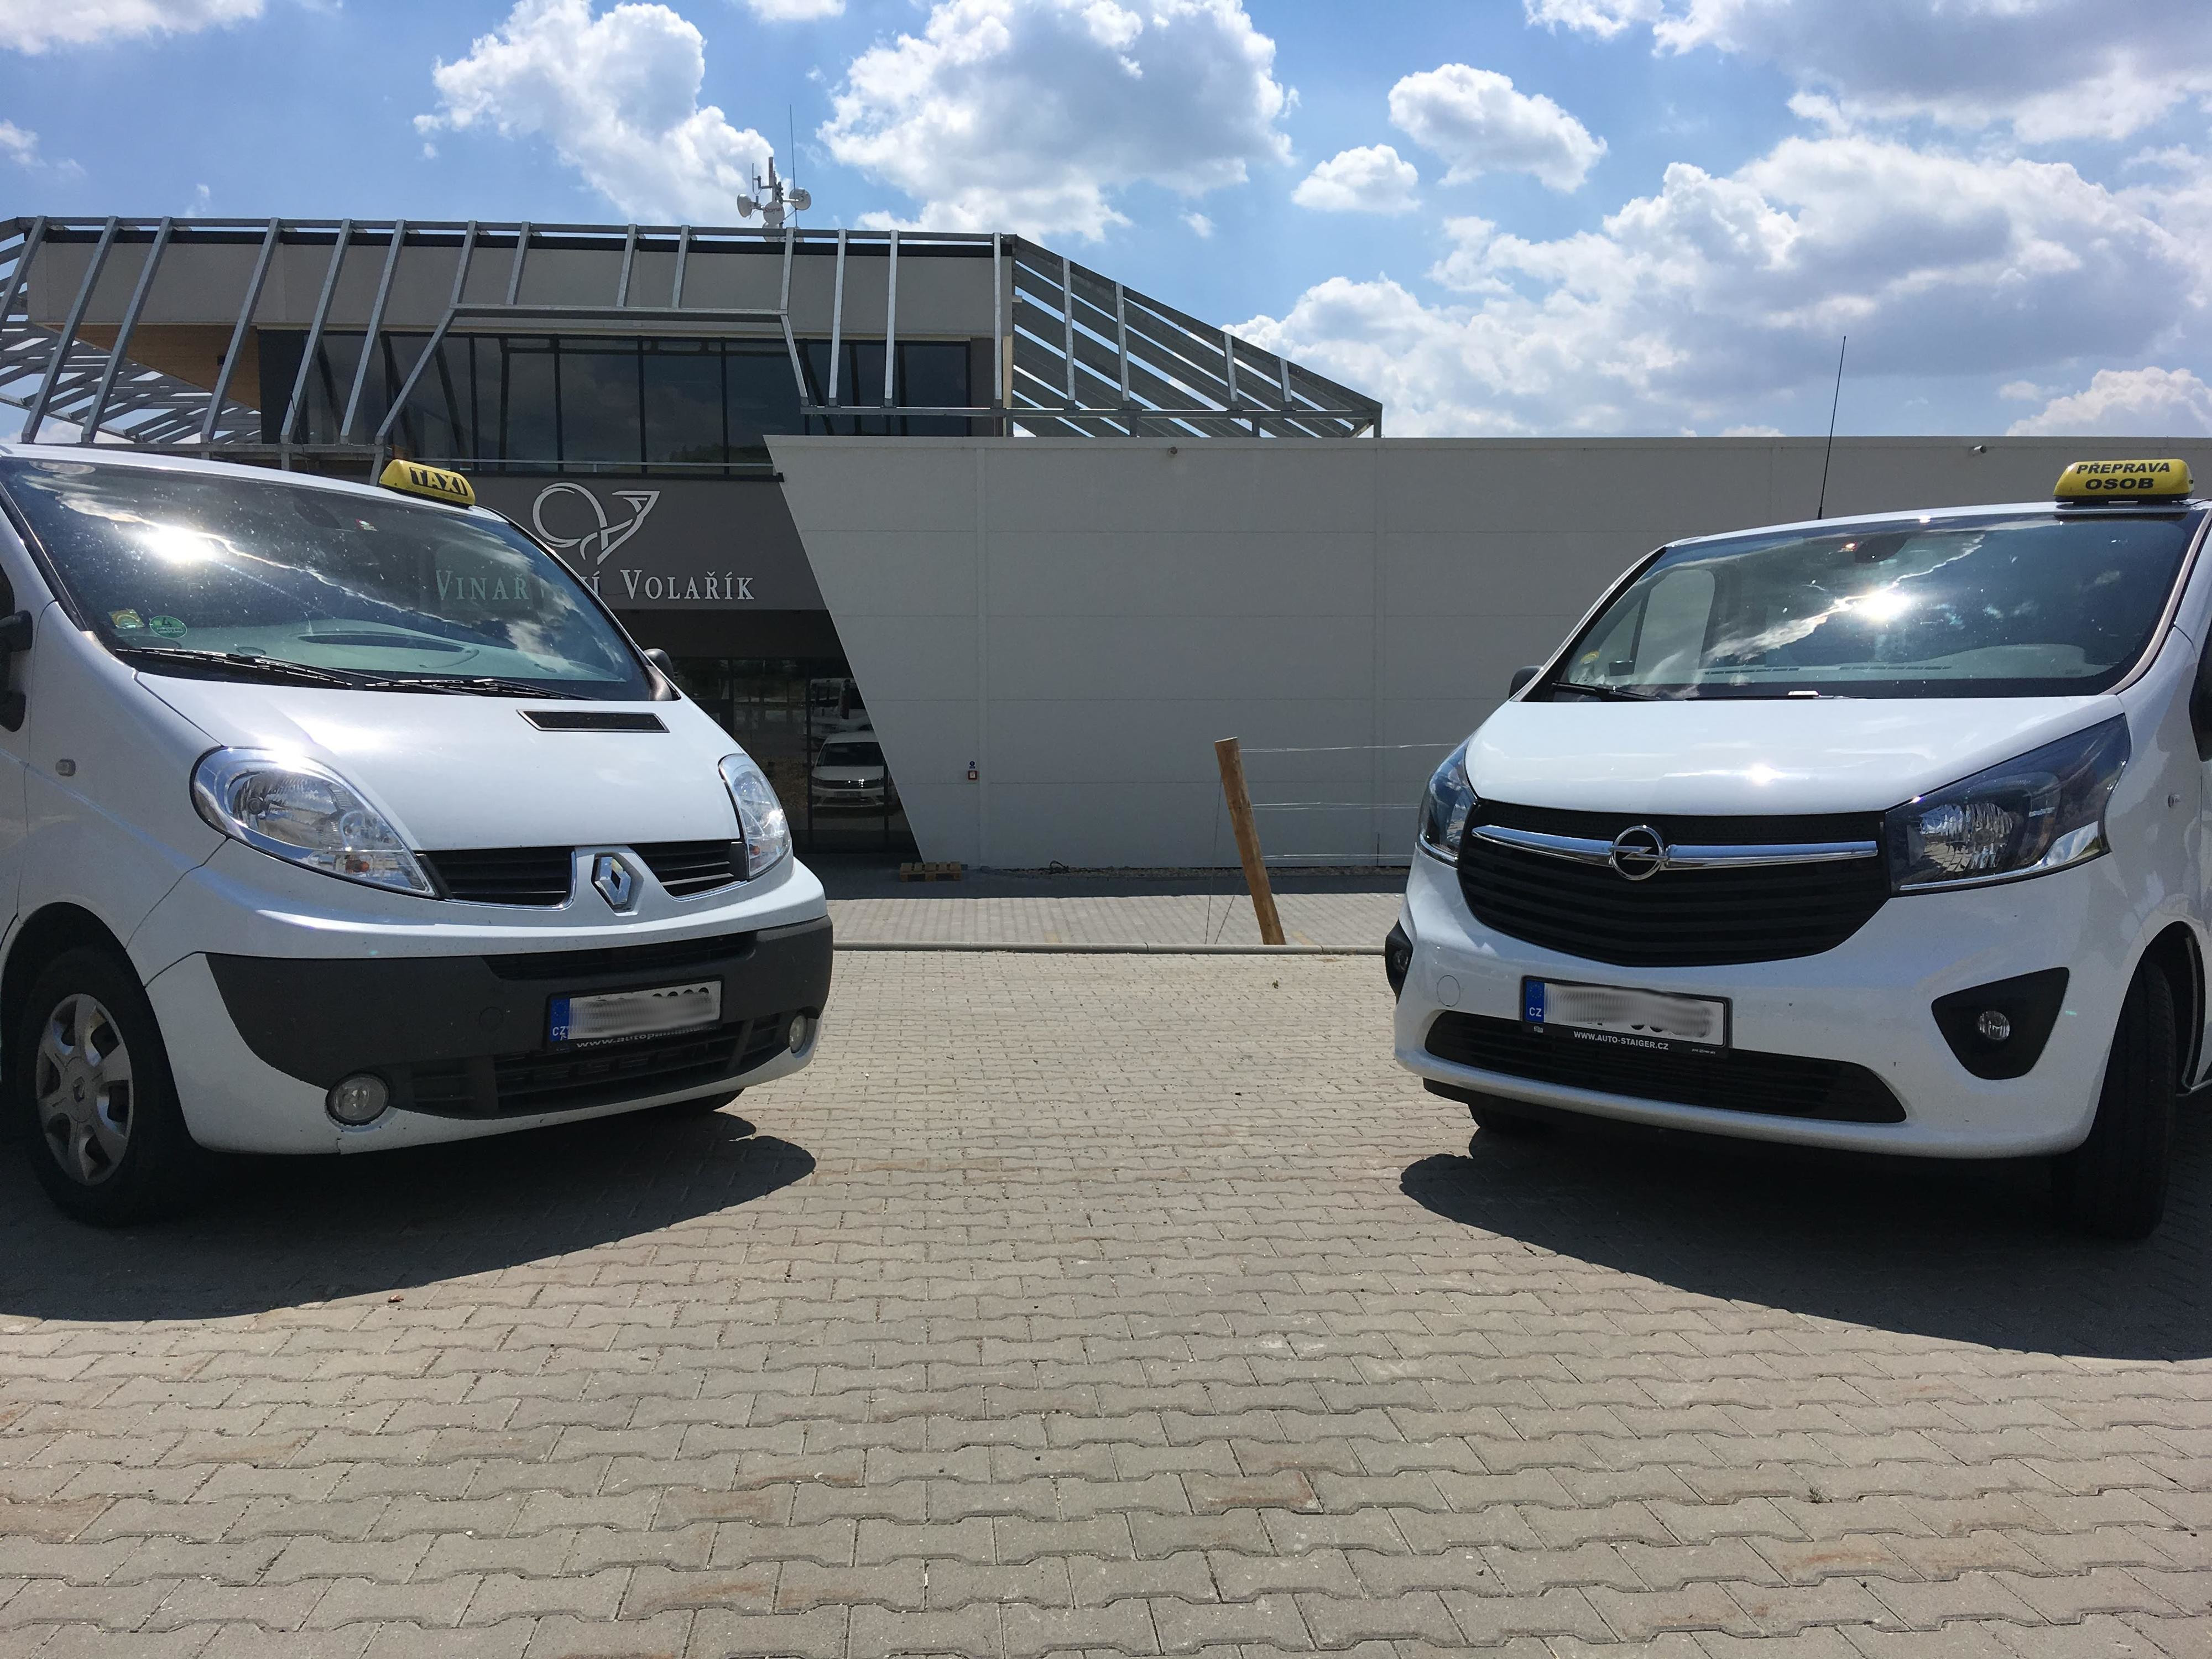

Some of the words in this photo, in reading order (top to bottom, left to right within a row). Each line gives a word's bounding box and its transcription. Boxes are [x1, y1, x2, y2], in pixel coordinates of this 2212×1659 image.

[2076, 462, 2171, 474] PŘEPRAVA
[410, 467, 466, 495] TAXI
[2085, 478, 2154, 489] OSOB
[436, 570, 601, 600] VINAŘÍ
[620, 570, 754, 599] VOLAŘÍK
[1529, 1007, 1542, 1017] CZ
[552, 1026, 566, 1036] CZ
[1573, 1031, 1669, 1050] WWW.AUTO-STAIGER.CZ
